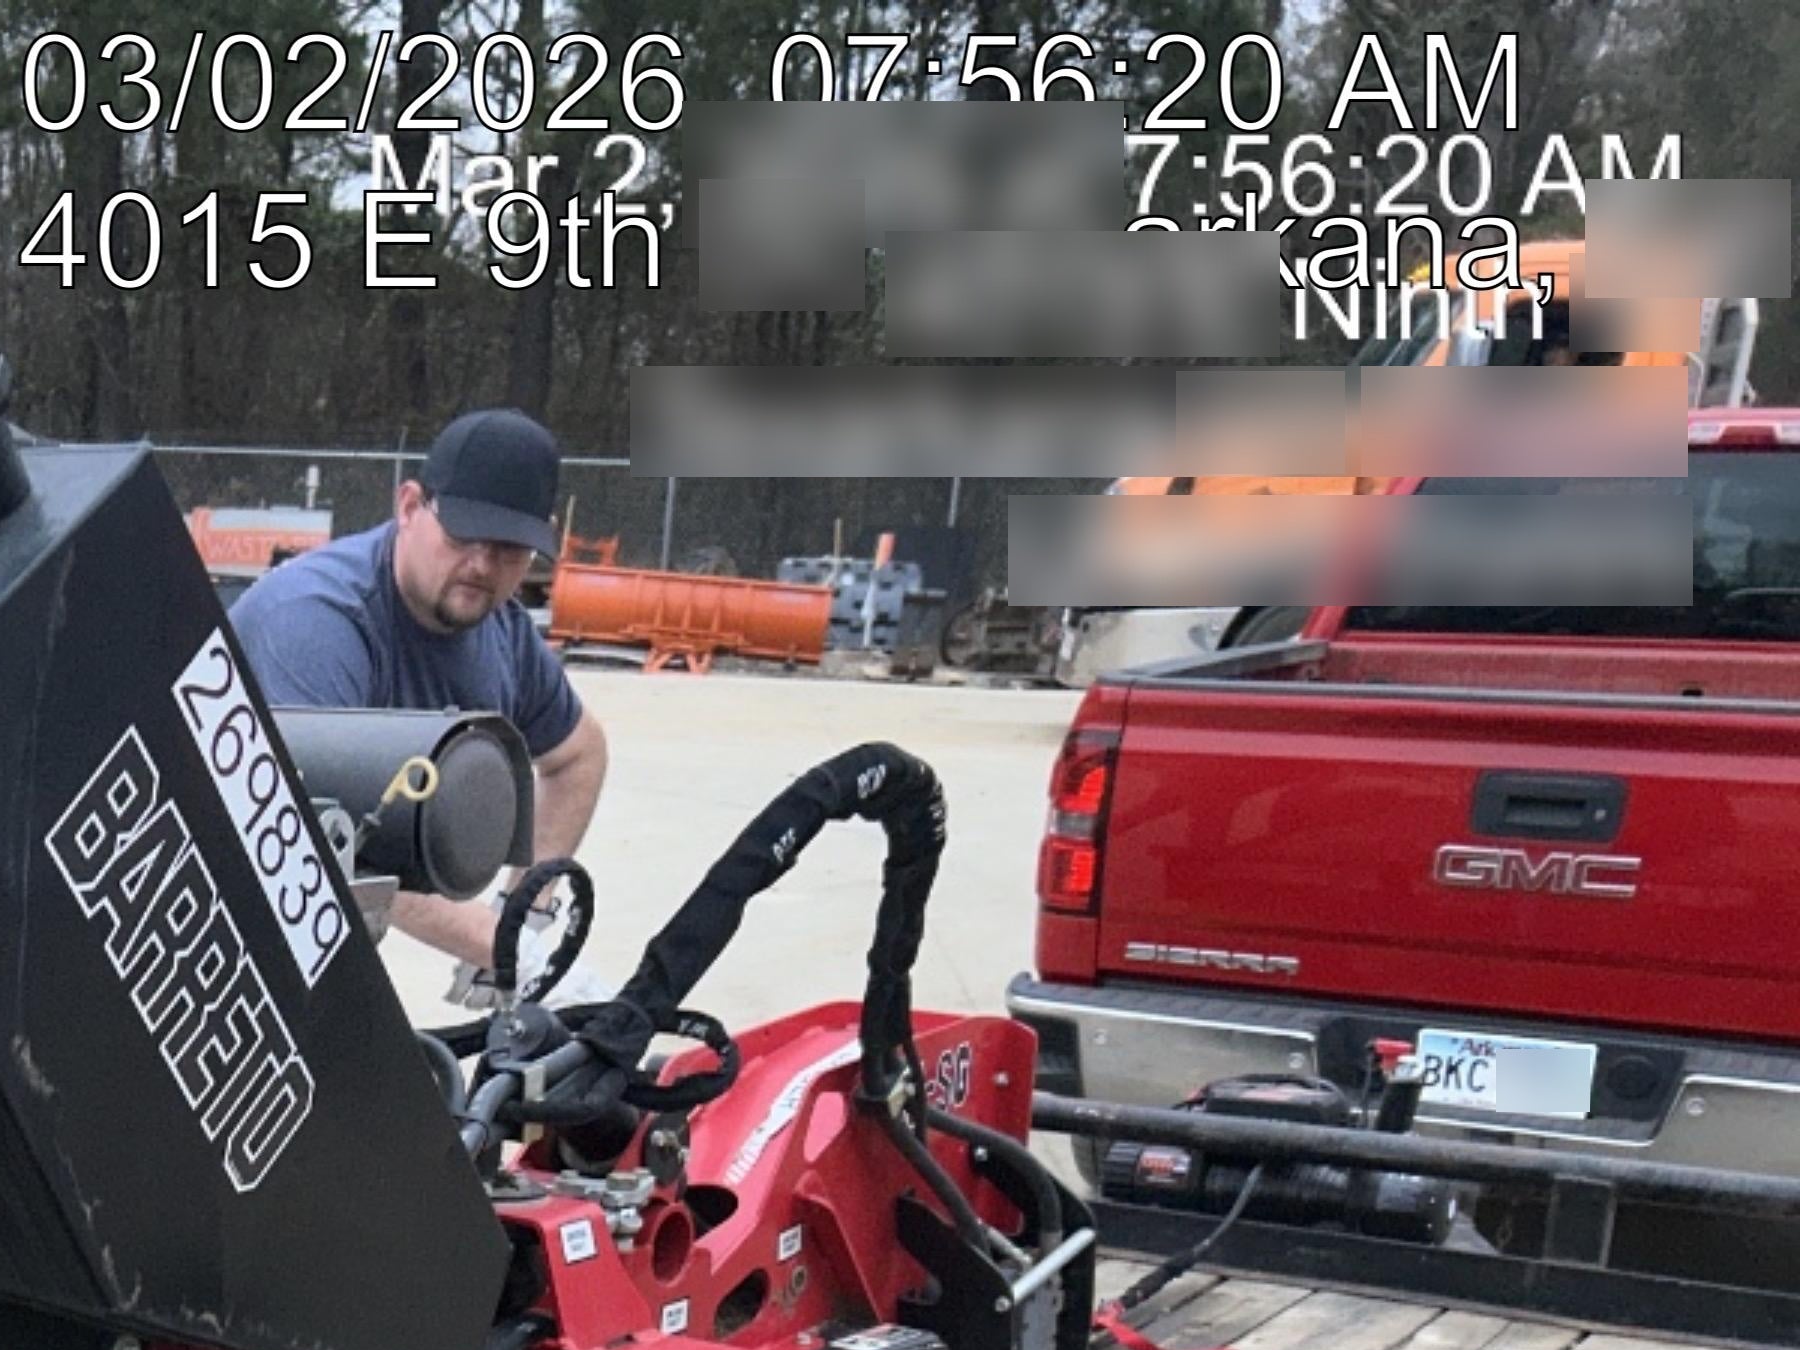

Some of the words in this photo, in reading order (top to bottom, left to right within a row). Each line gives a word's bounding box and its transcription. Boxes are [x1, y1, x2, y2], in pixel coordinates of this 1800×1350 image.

[181, 646, 350, 977] 269839
[1434, 844, 1642, 898] GMC
[44, 725, 316, 1193] BARRETO
[1124, 941, 1299, 976] SIERRA
[1423, 1054, 1490, 1093] BKC
